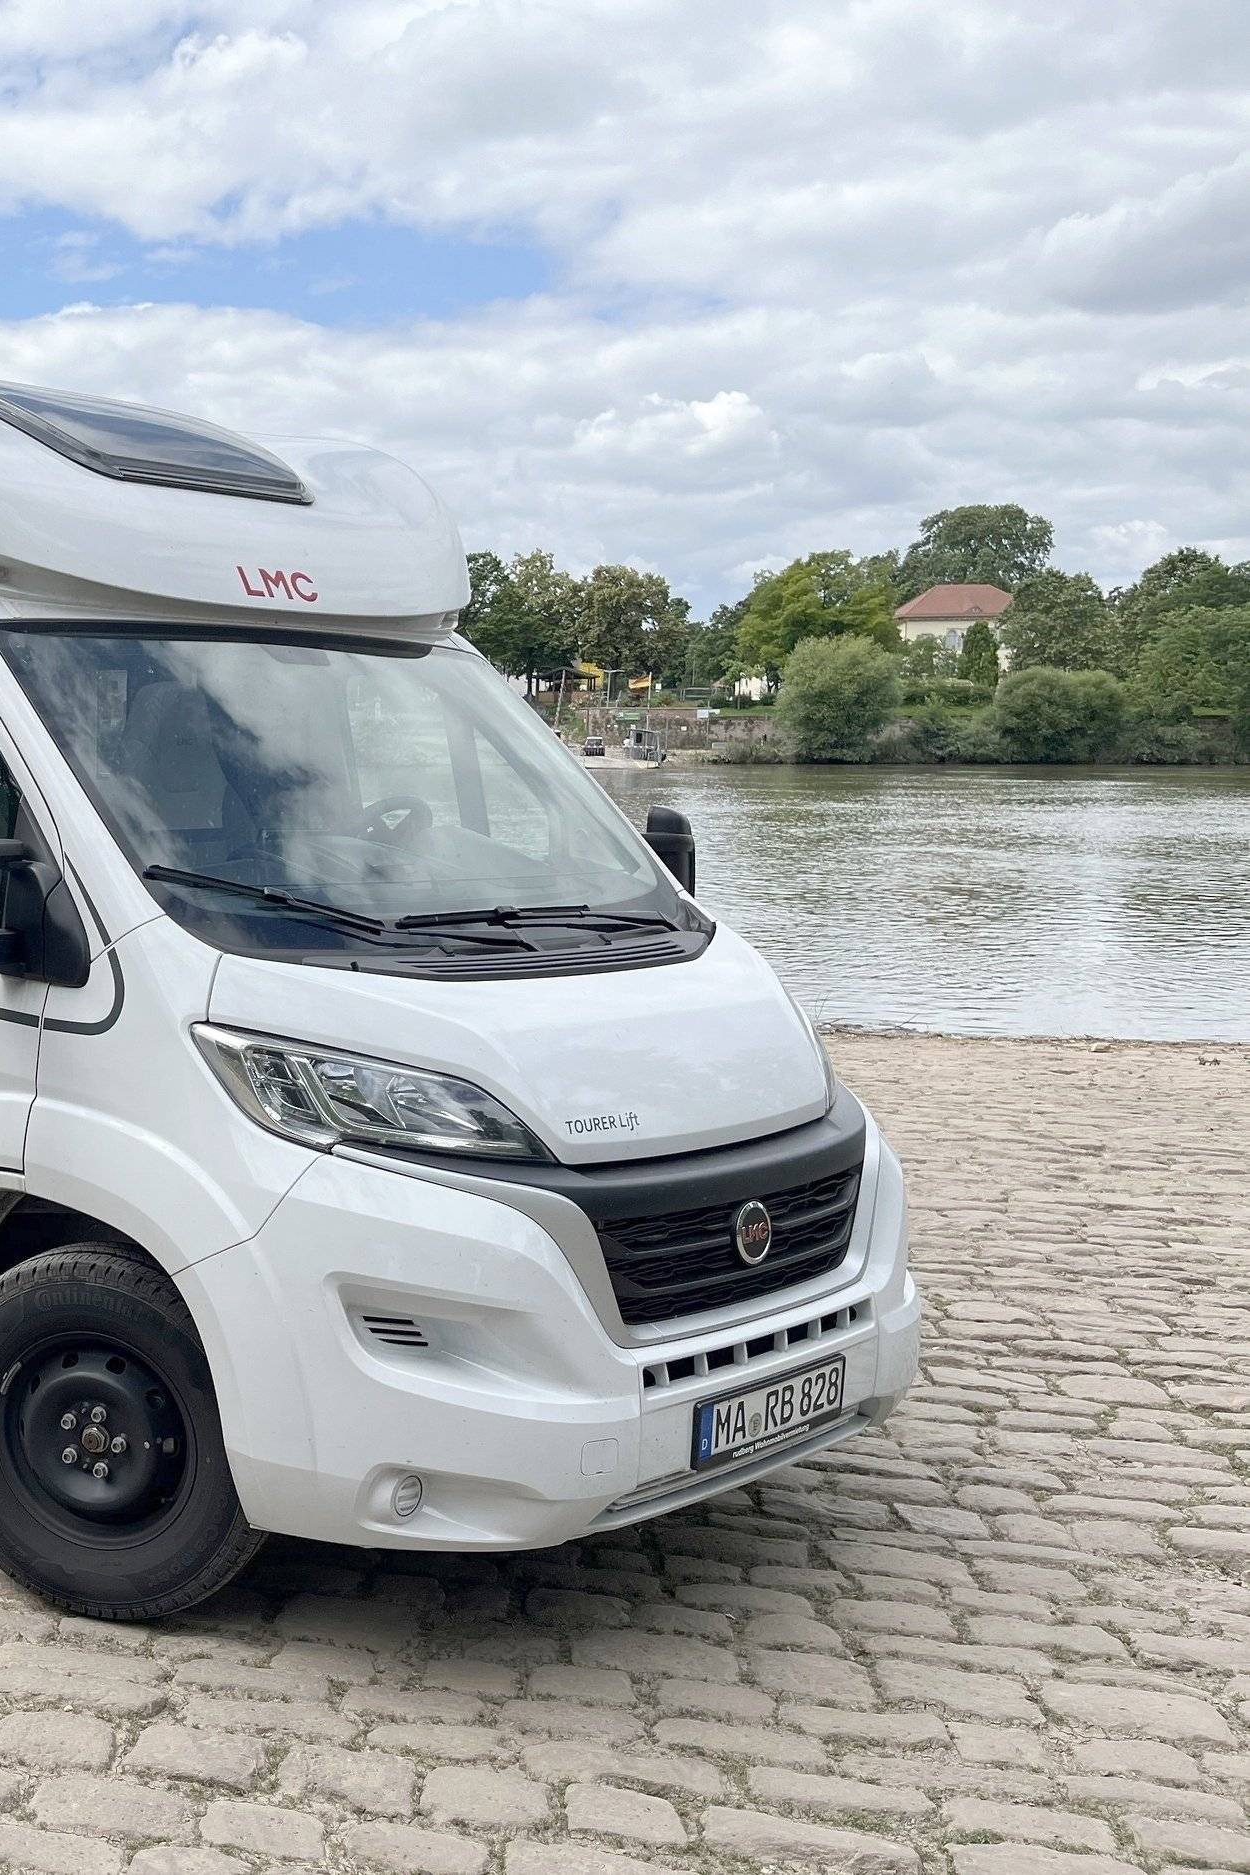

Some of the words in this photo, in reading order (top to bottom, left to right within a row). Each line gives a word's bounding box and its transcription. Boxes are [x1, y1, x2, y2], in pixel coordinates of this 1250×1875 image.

[236, 565, 319, 602] LMC
[565, 1115, 617, 1134] TOURER
[618, 1111, 640, 1131] Lift
[715, 1401, 746, 1449] MA
[764, 1384, 794, 1431] RB
[800, 1366, 839, 1417] 828
[701, 1438, 708, 1450] D
